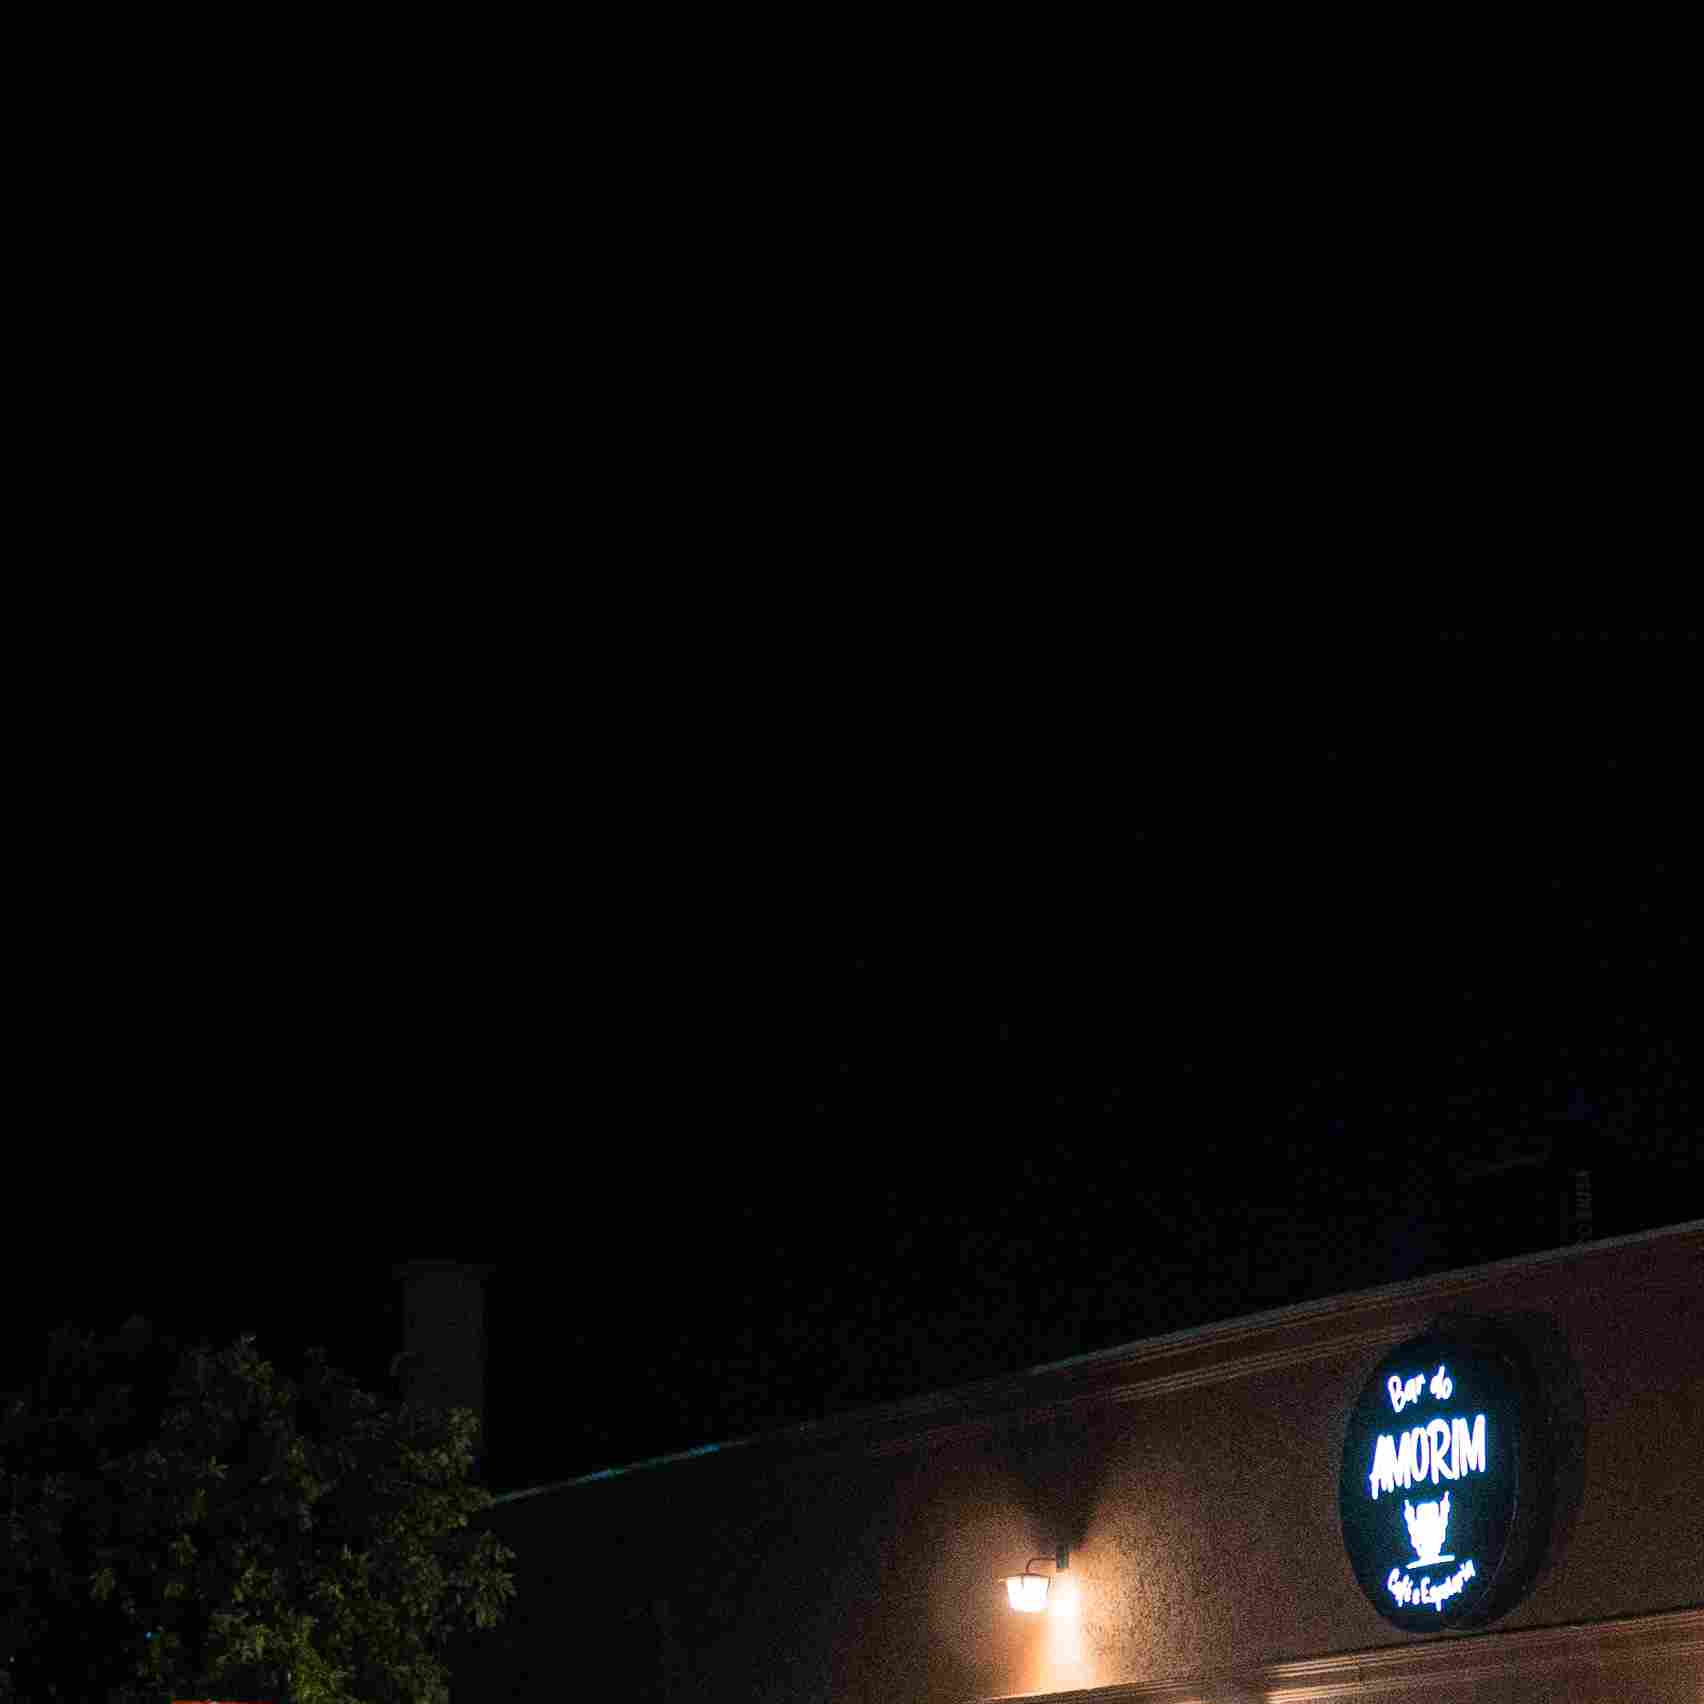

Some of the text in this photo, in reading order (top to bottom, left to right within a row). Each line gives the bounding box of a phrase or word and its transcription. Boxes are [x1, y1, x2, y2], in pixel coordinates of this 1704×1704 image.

[1388, 1365, 1452, 1413] Bar do
[1369, 1414, 1487, 1500] AMORIM
